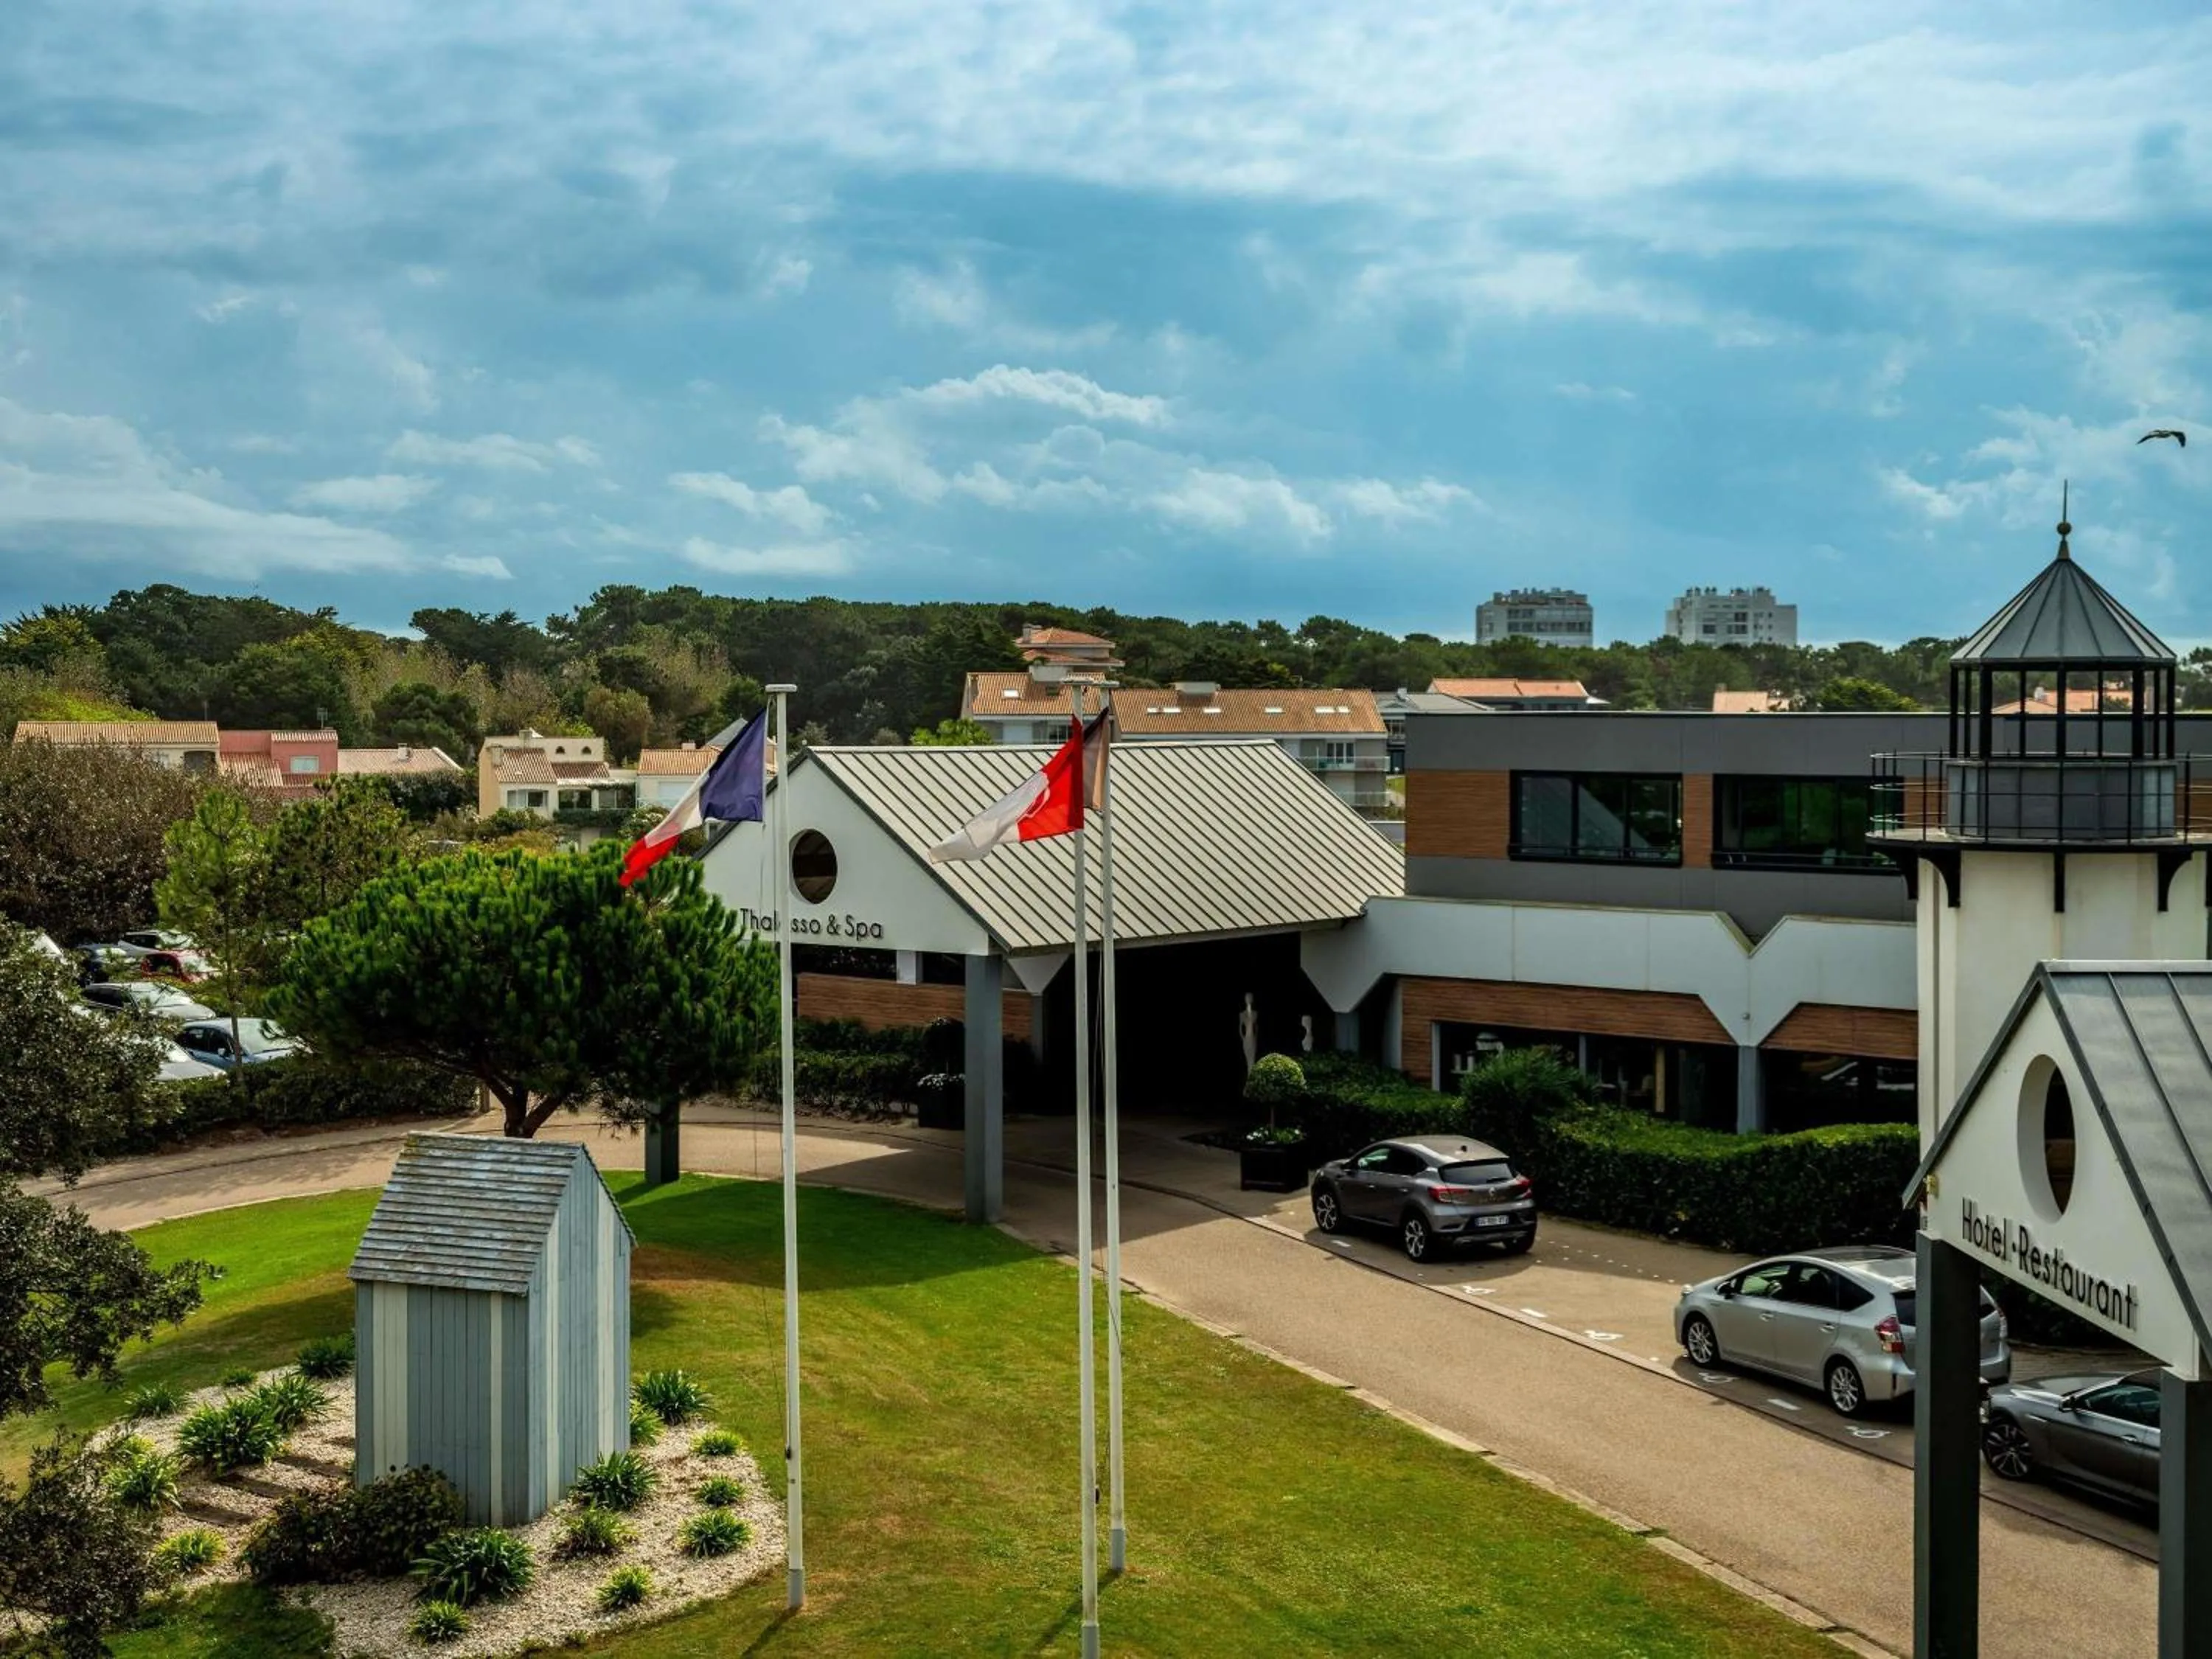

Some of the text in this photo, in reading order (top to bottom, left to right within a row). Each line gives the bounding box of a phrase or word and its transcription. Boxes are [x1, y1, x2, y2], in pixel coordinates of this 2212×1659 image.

[740, 908, 882, 942] Thalsso & Spa
